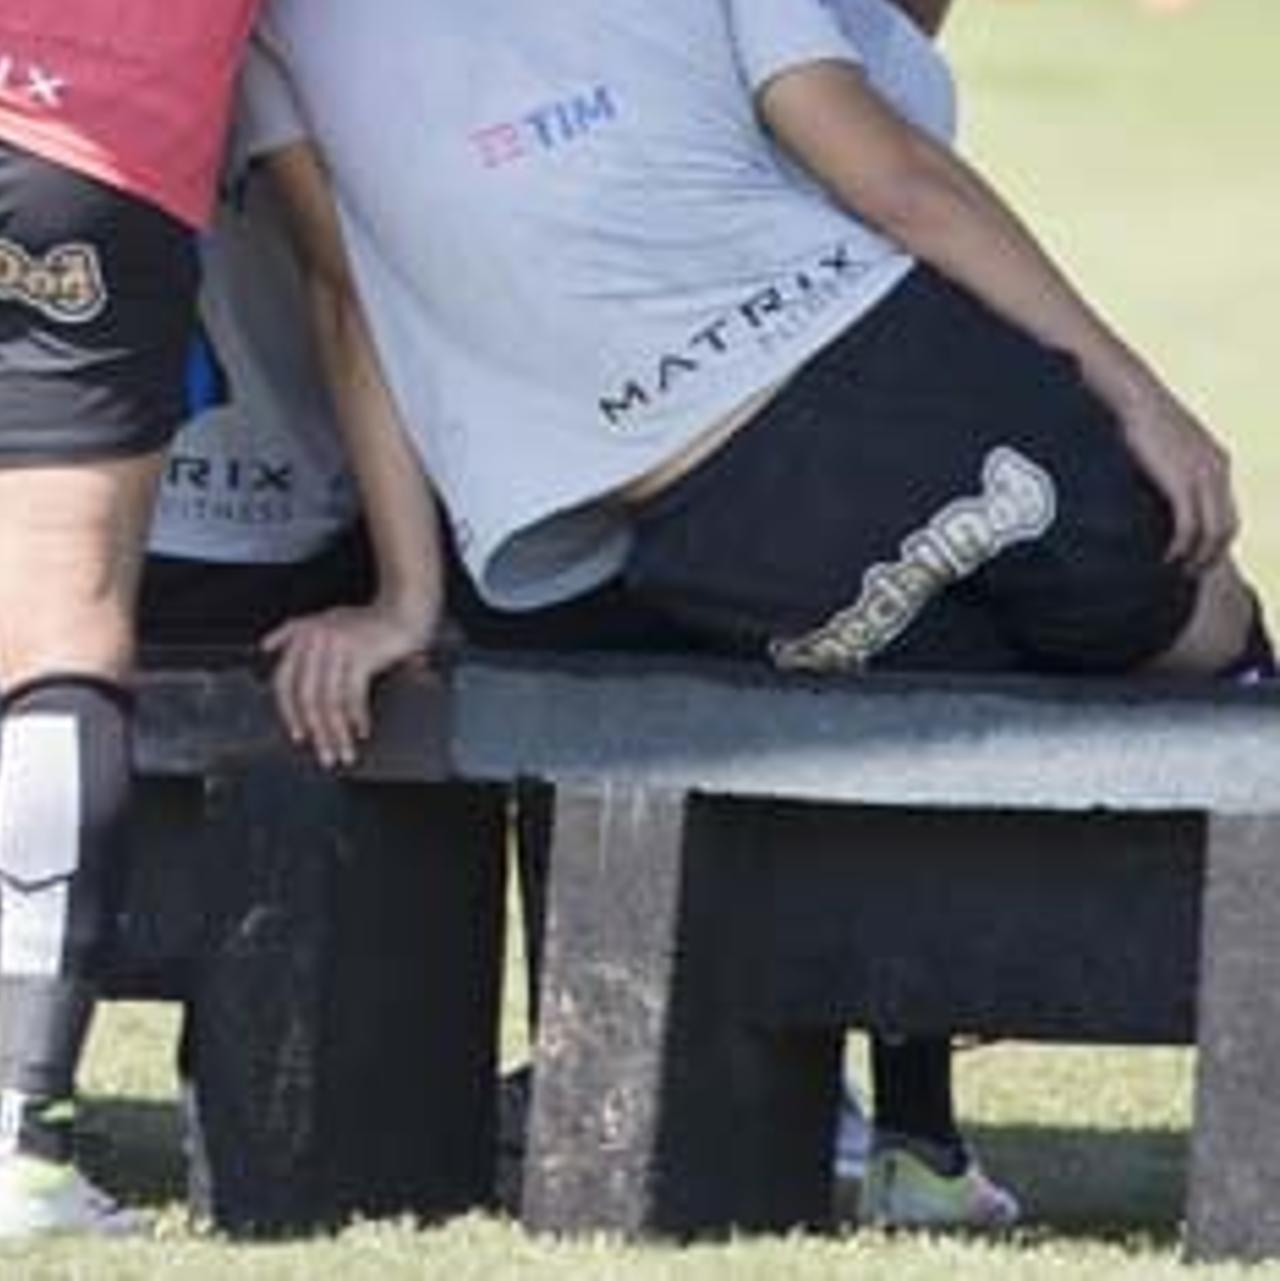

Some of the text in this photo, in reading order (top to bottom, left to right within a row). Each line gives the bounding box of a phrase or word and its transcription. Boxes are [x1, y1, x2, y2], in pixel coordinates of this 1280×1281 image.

[523, 85, 617, 149] TIM
[598, 242, 872, 425] MATRIX
[166, 456, 293, 492] RIX
